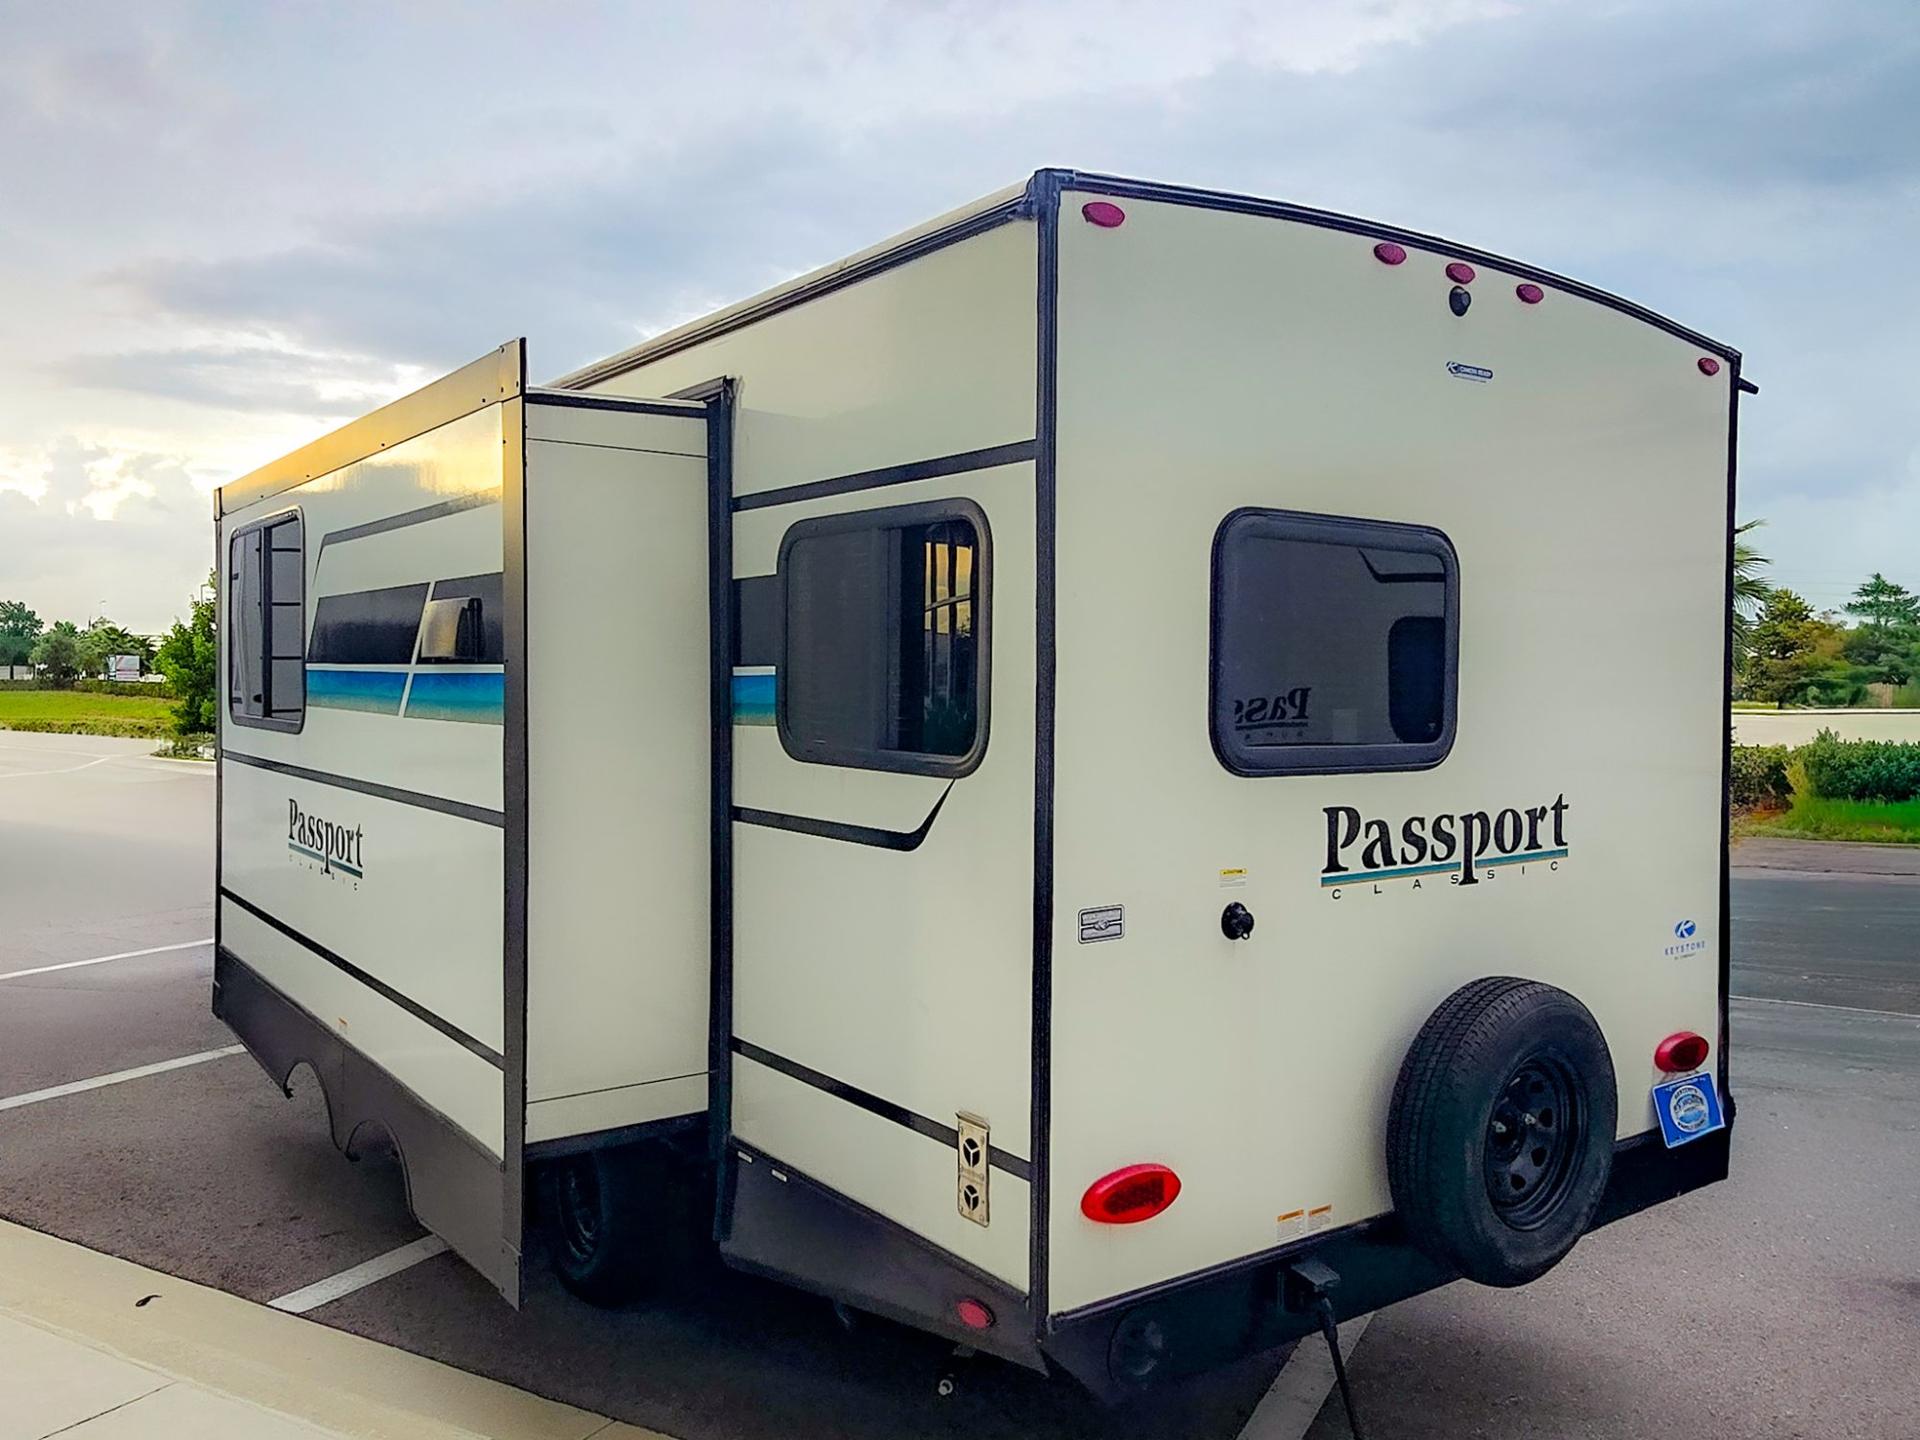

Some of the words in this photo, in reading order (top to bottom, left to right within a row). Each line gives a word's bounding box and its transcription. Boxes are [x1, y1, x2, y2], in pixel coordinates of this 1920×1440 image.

[288, 798, 363, 875] Passport
[1321, 793, 1570, 886] Passport
[1331, 860, 1559, 900] CLASSIC
[1664, 940, 1706, 956] KEYSTONE
